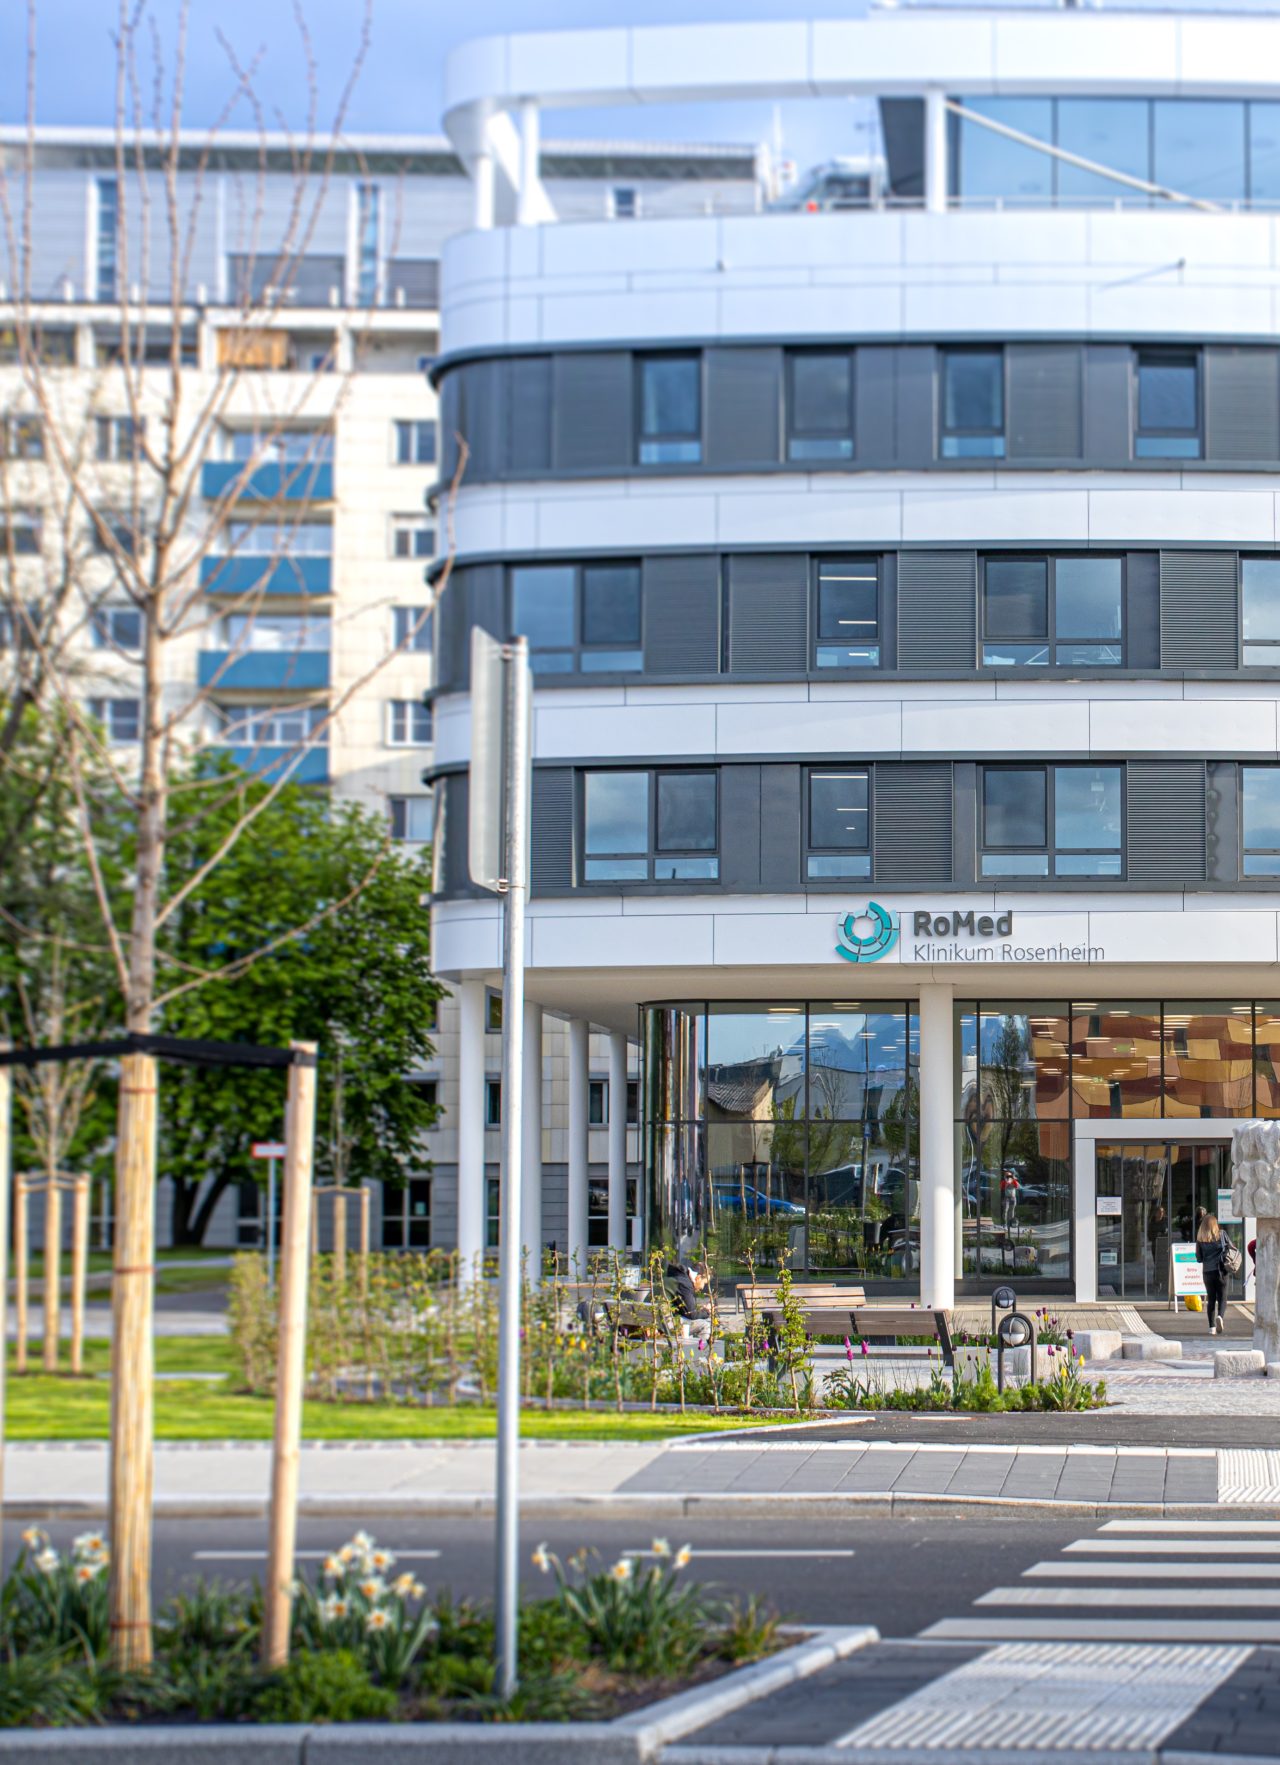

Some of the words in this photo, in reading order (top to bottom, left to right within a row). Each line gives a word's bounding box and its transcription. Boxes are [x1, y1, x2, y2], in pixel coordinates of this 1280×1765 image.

[913, 909, 1013, 937] RoMed
[914, 943, 994, 961] Klinikum
[1002, 943, 1105, 961] Rosenheim
